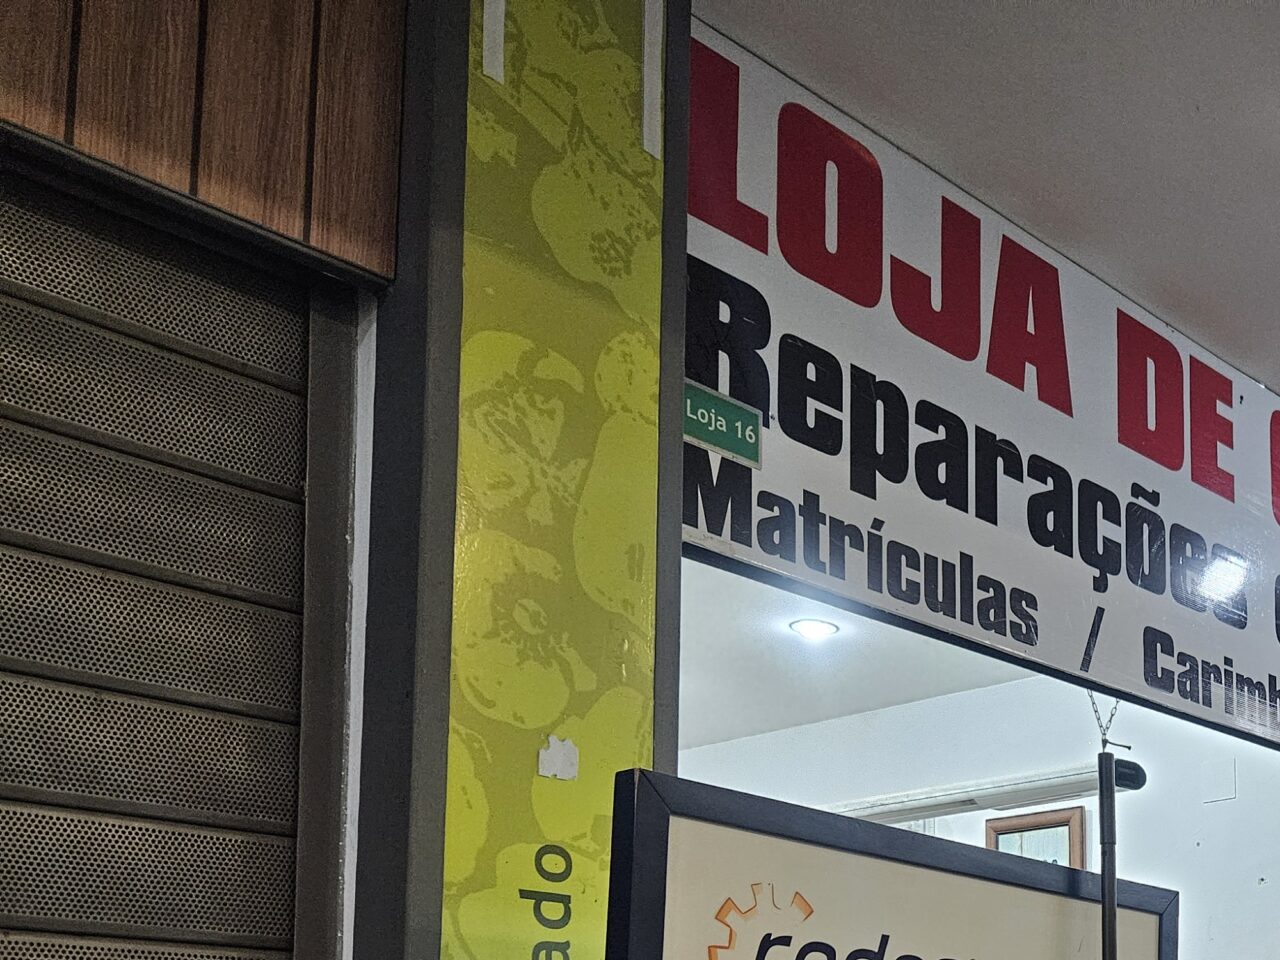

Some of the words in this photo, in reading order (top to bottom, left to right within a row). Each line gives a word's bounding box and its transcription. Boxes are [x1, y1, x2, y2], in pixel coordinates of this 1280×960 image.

[686, 397, 728, 433] Loja
[734, 420, 756, 444] 16
[688, 36, 1073, 418] LOJA
[1116, 307, 1235, 504] DE
[682, 443, 1039, 647] Matrículas
[1080, 607, 1105, 672] /
[685, 253, 1248, 630] Reparações
